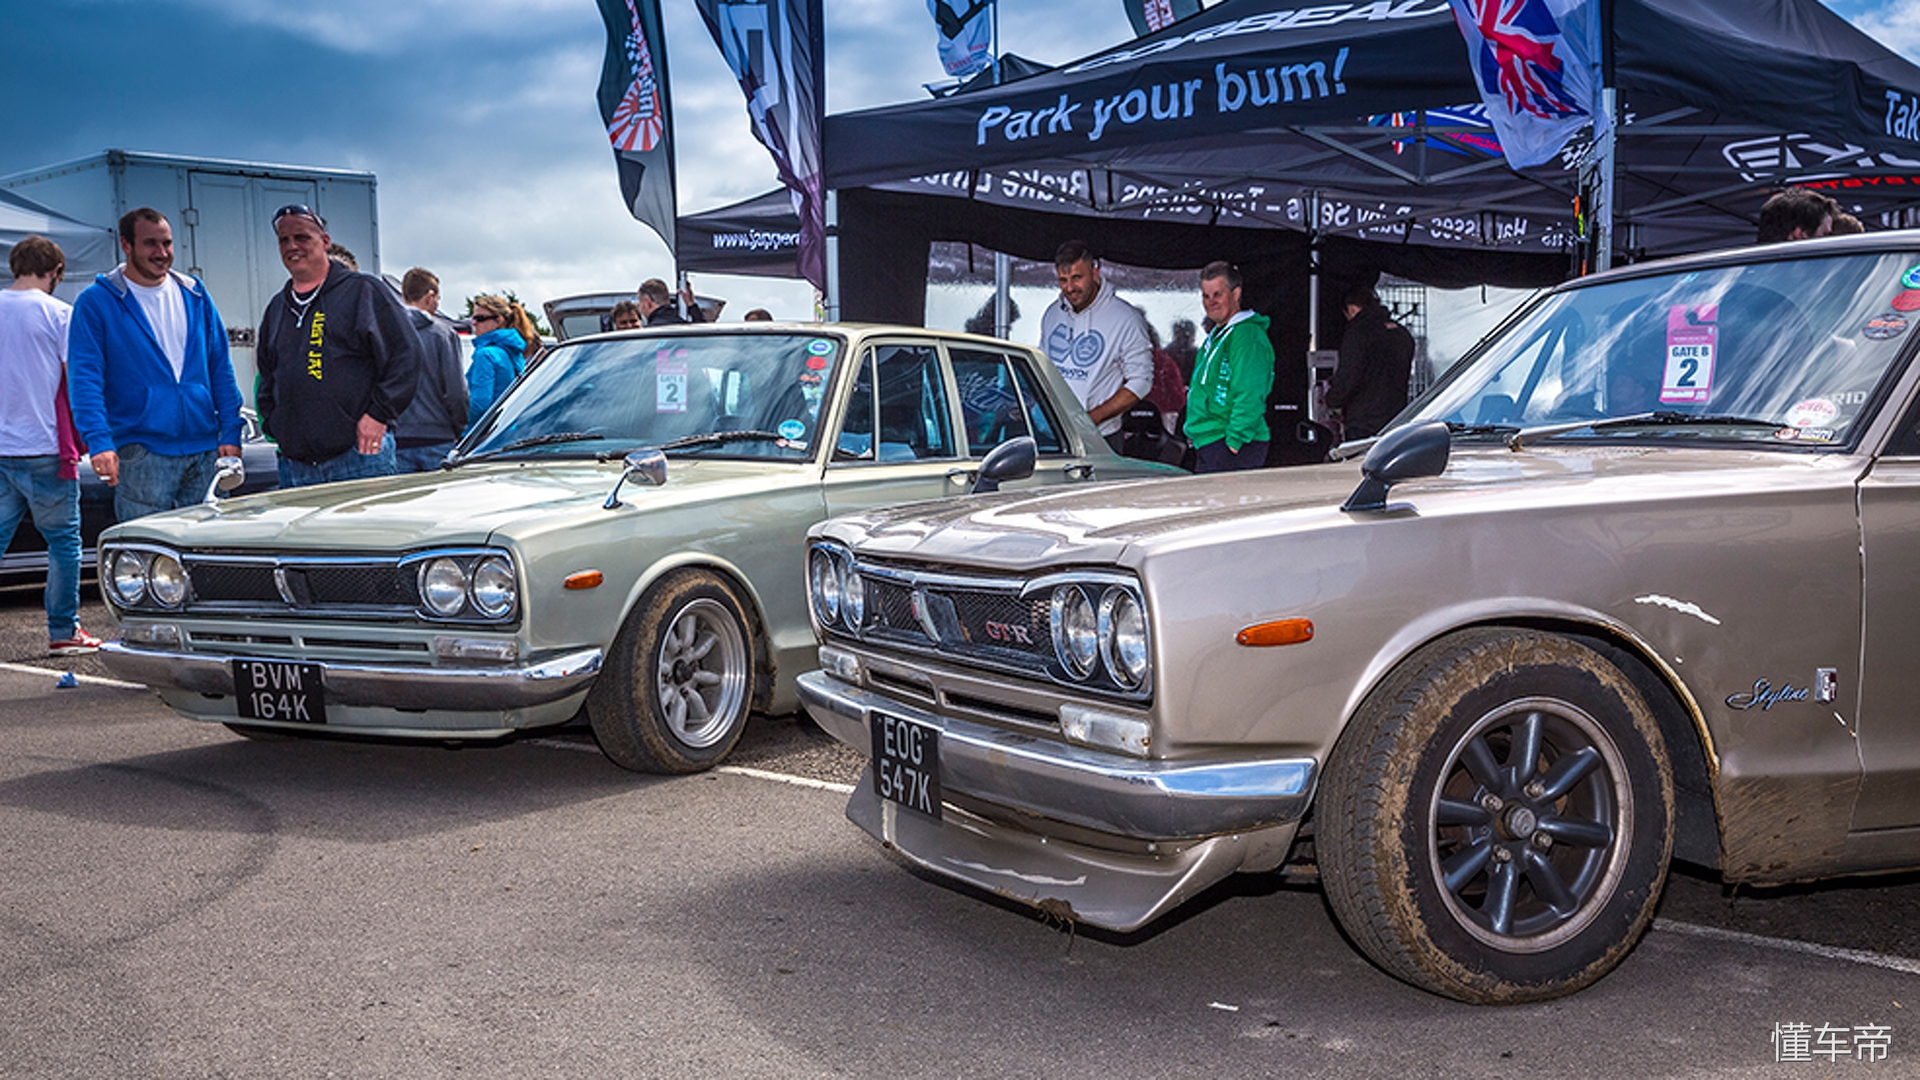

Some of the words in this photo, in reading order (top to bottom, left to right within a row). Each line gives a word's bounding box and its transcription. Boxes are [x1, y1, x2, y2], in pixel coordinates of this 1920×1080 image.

[976, 94, 1081, 146] Park
[1088, 79, 1203, 141] your
[1215, 47, 1350, 113] bum!
[1672, 347, 1698, 358] GATE
[1676, 358, 1699, 387] 2
[666, 383, 678, 401] 2
[985, 621, 1034, 645] GTR
[251, 662, 302, 690] BVM
[250, 691, 311, 722] 164K
[884, 717, 923, 765] EOG
[880, 759, 932, 813] 547K
